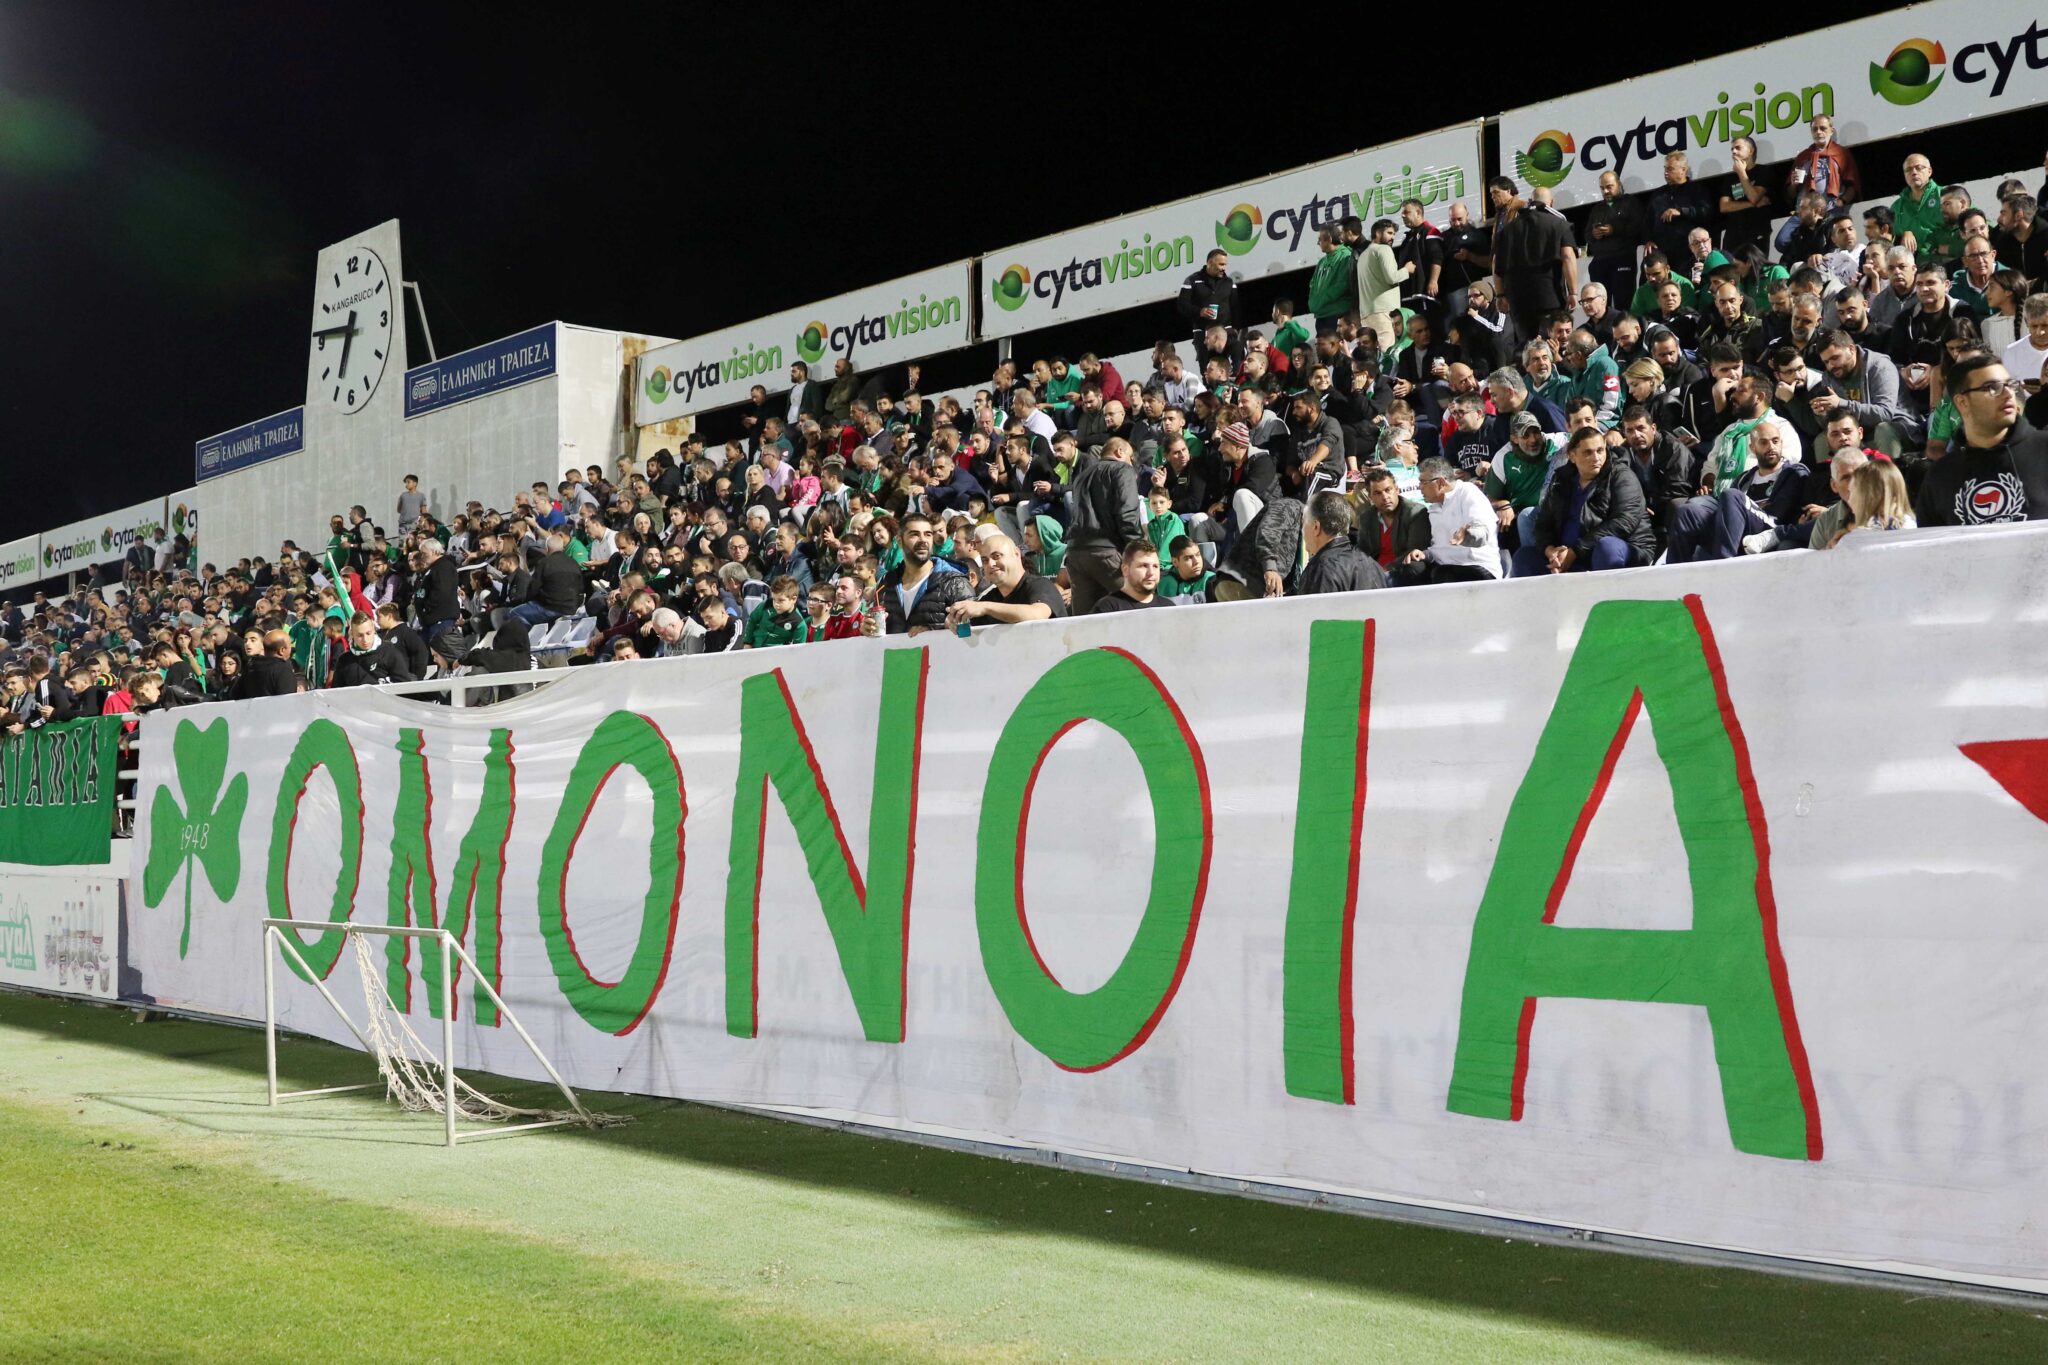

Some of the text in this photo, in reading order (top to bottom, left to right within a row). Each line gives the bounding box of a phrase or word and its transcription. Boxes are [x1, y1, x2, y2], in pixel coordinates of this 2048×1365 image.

[1580, 81, 1835, 176] cytavision
[1266, 164, 1465, 252] cytavision
[347, 256, 358, 274] 12
[1034, 233, 1194, 309] cytavision
[331, 288, 374, 313] KANGARUCCI
[380, 311, 388, 327] 3
[829, 292, 961, 359] cytavision
[441, 341, 550, 393] ΕΛΛΗΝΙΚΗ ΤΡΑΠΕΖΑ
[673, 342, 782, 402] cytavision
[348, 389, 355, 406] 6
[263, 421, 299, 448] ΤΡΑΠΕΖΑ
[54, 536, 96, 569] cytavision
[180, 823, 210, 850] 1948
